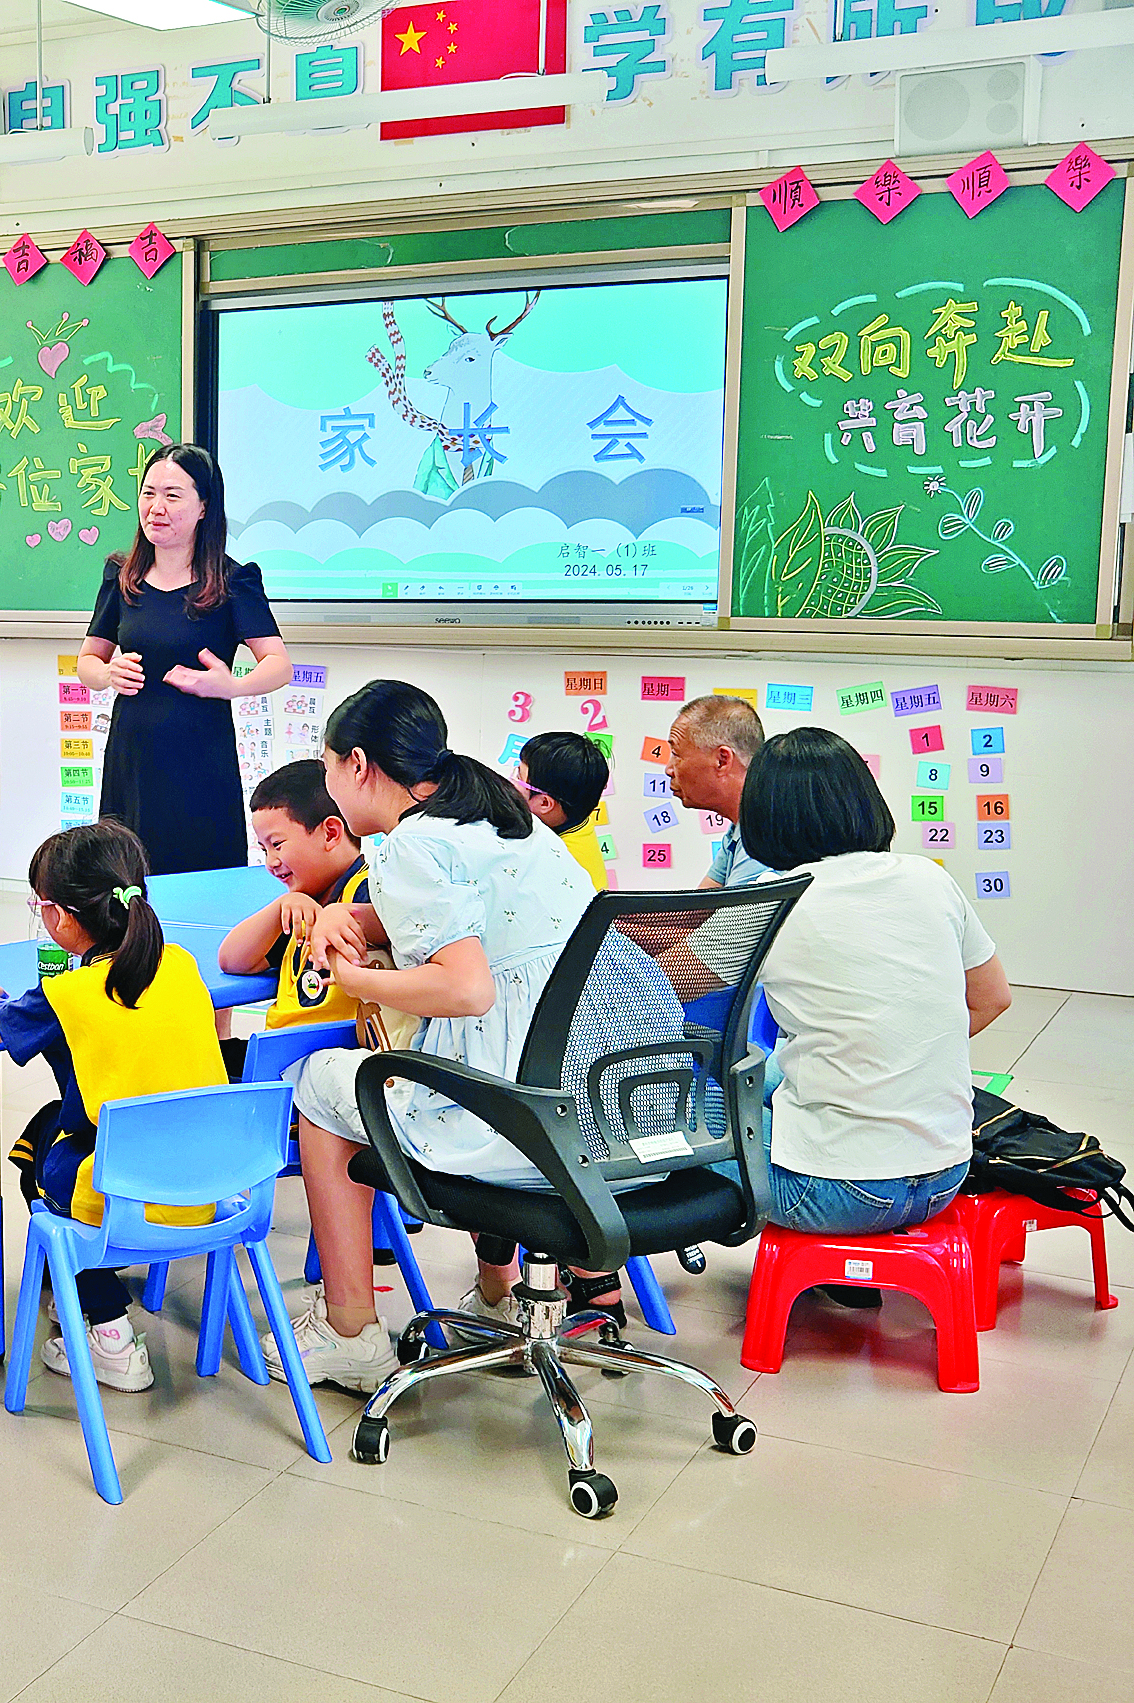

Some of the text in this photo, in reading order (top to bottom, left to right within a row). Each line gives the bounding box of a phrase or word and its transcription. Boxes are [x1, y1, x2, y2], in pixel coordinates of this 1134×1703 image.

[70, 239, 99, 265] 福
[140, 230, 158, 262] 吉
[13, 241, 30, 273] 吉
[794, 298, 1074, 390] 双向奔赴
[837, 387, 1063, 459] 共育花开
[319, 394, 654, 473] 家长会
[564, 563, 649, 578] 2024.05.17
[292, 670, 325, 683] 星期五
[566, 677, 604, 691] 星期日
[62, 685, 87, 695] 第一节
[642, 682, 684, 697] 星期一
[768, 690, 811, 706] 星期三
[841, 688, 884, 709] 星期四
[894, 691, 940, 711] 星期五
[969, 692, 1015, 709] 星期六
[508, 691, 533, 723] 3
[64, 713, 88, 723] 第二节
[580, 699, 608, 732] 2
[264, 718, 272, 736] 主题
[64, 740, 89, 750] 第三节
[921, 732, 930, 747] 1
[982, 734, 993, 748] 2
[260, 740, 269, 758] 音乐
[651, 745, 662, 758] 4
[64, 768, 89, 778] 第四节
[928, 768, 938, 781] 8
[980, 763, 990, 777] 9
[649, 779, 667, 793] 11
[64, 794, 89, 805] 第五节
[918, 801, 938, 815] 15
[983, 801, 1004, 815] 16
[652, 811, 671, 827] 18
[705, 814, 724, 827] 19
[928, 828, 949, 842] 22
[983, 829, 1005, 844] 23
[600, 841, 610, 854] 4
[647, 849, 666, 863] 25
[982, 878, 1004, 893] 30
